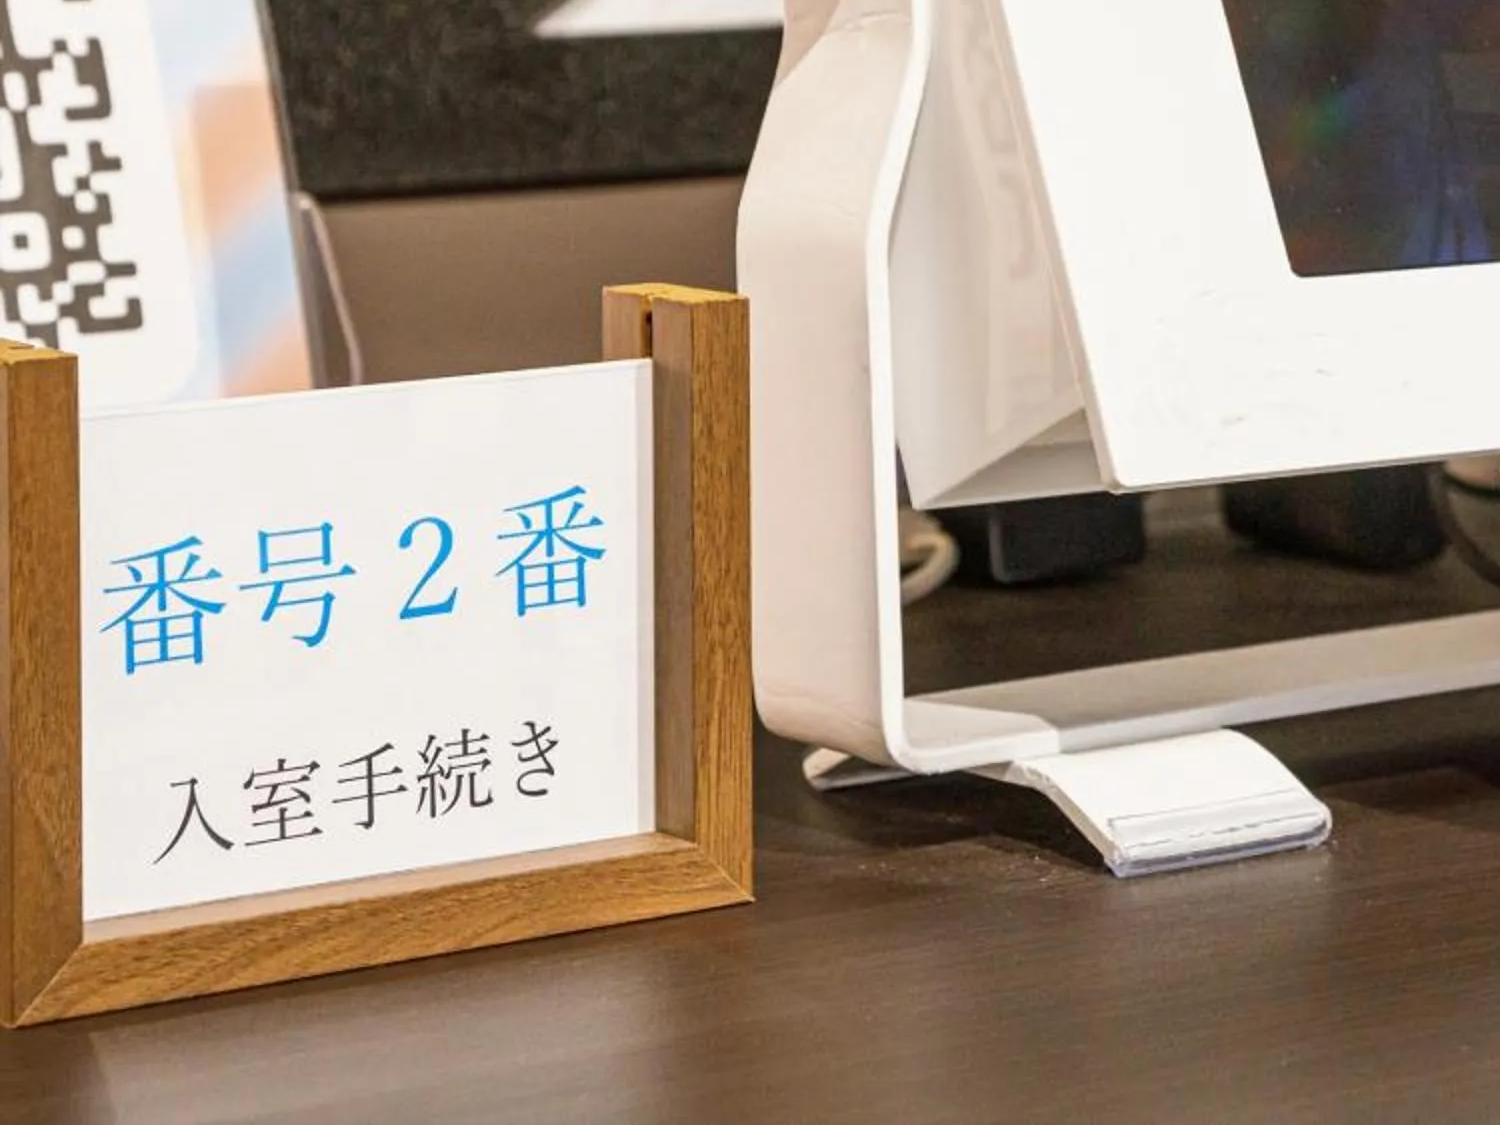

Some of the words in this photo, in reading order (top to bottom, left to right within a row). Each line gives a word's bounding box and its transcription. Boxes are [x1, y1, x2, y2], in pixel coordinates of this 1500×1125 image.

[152, 720, 562, 867] 入室手続き
